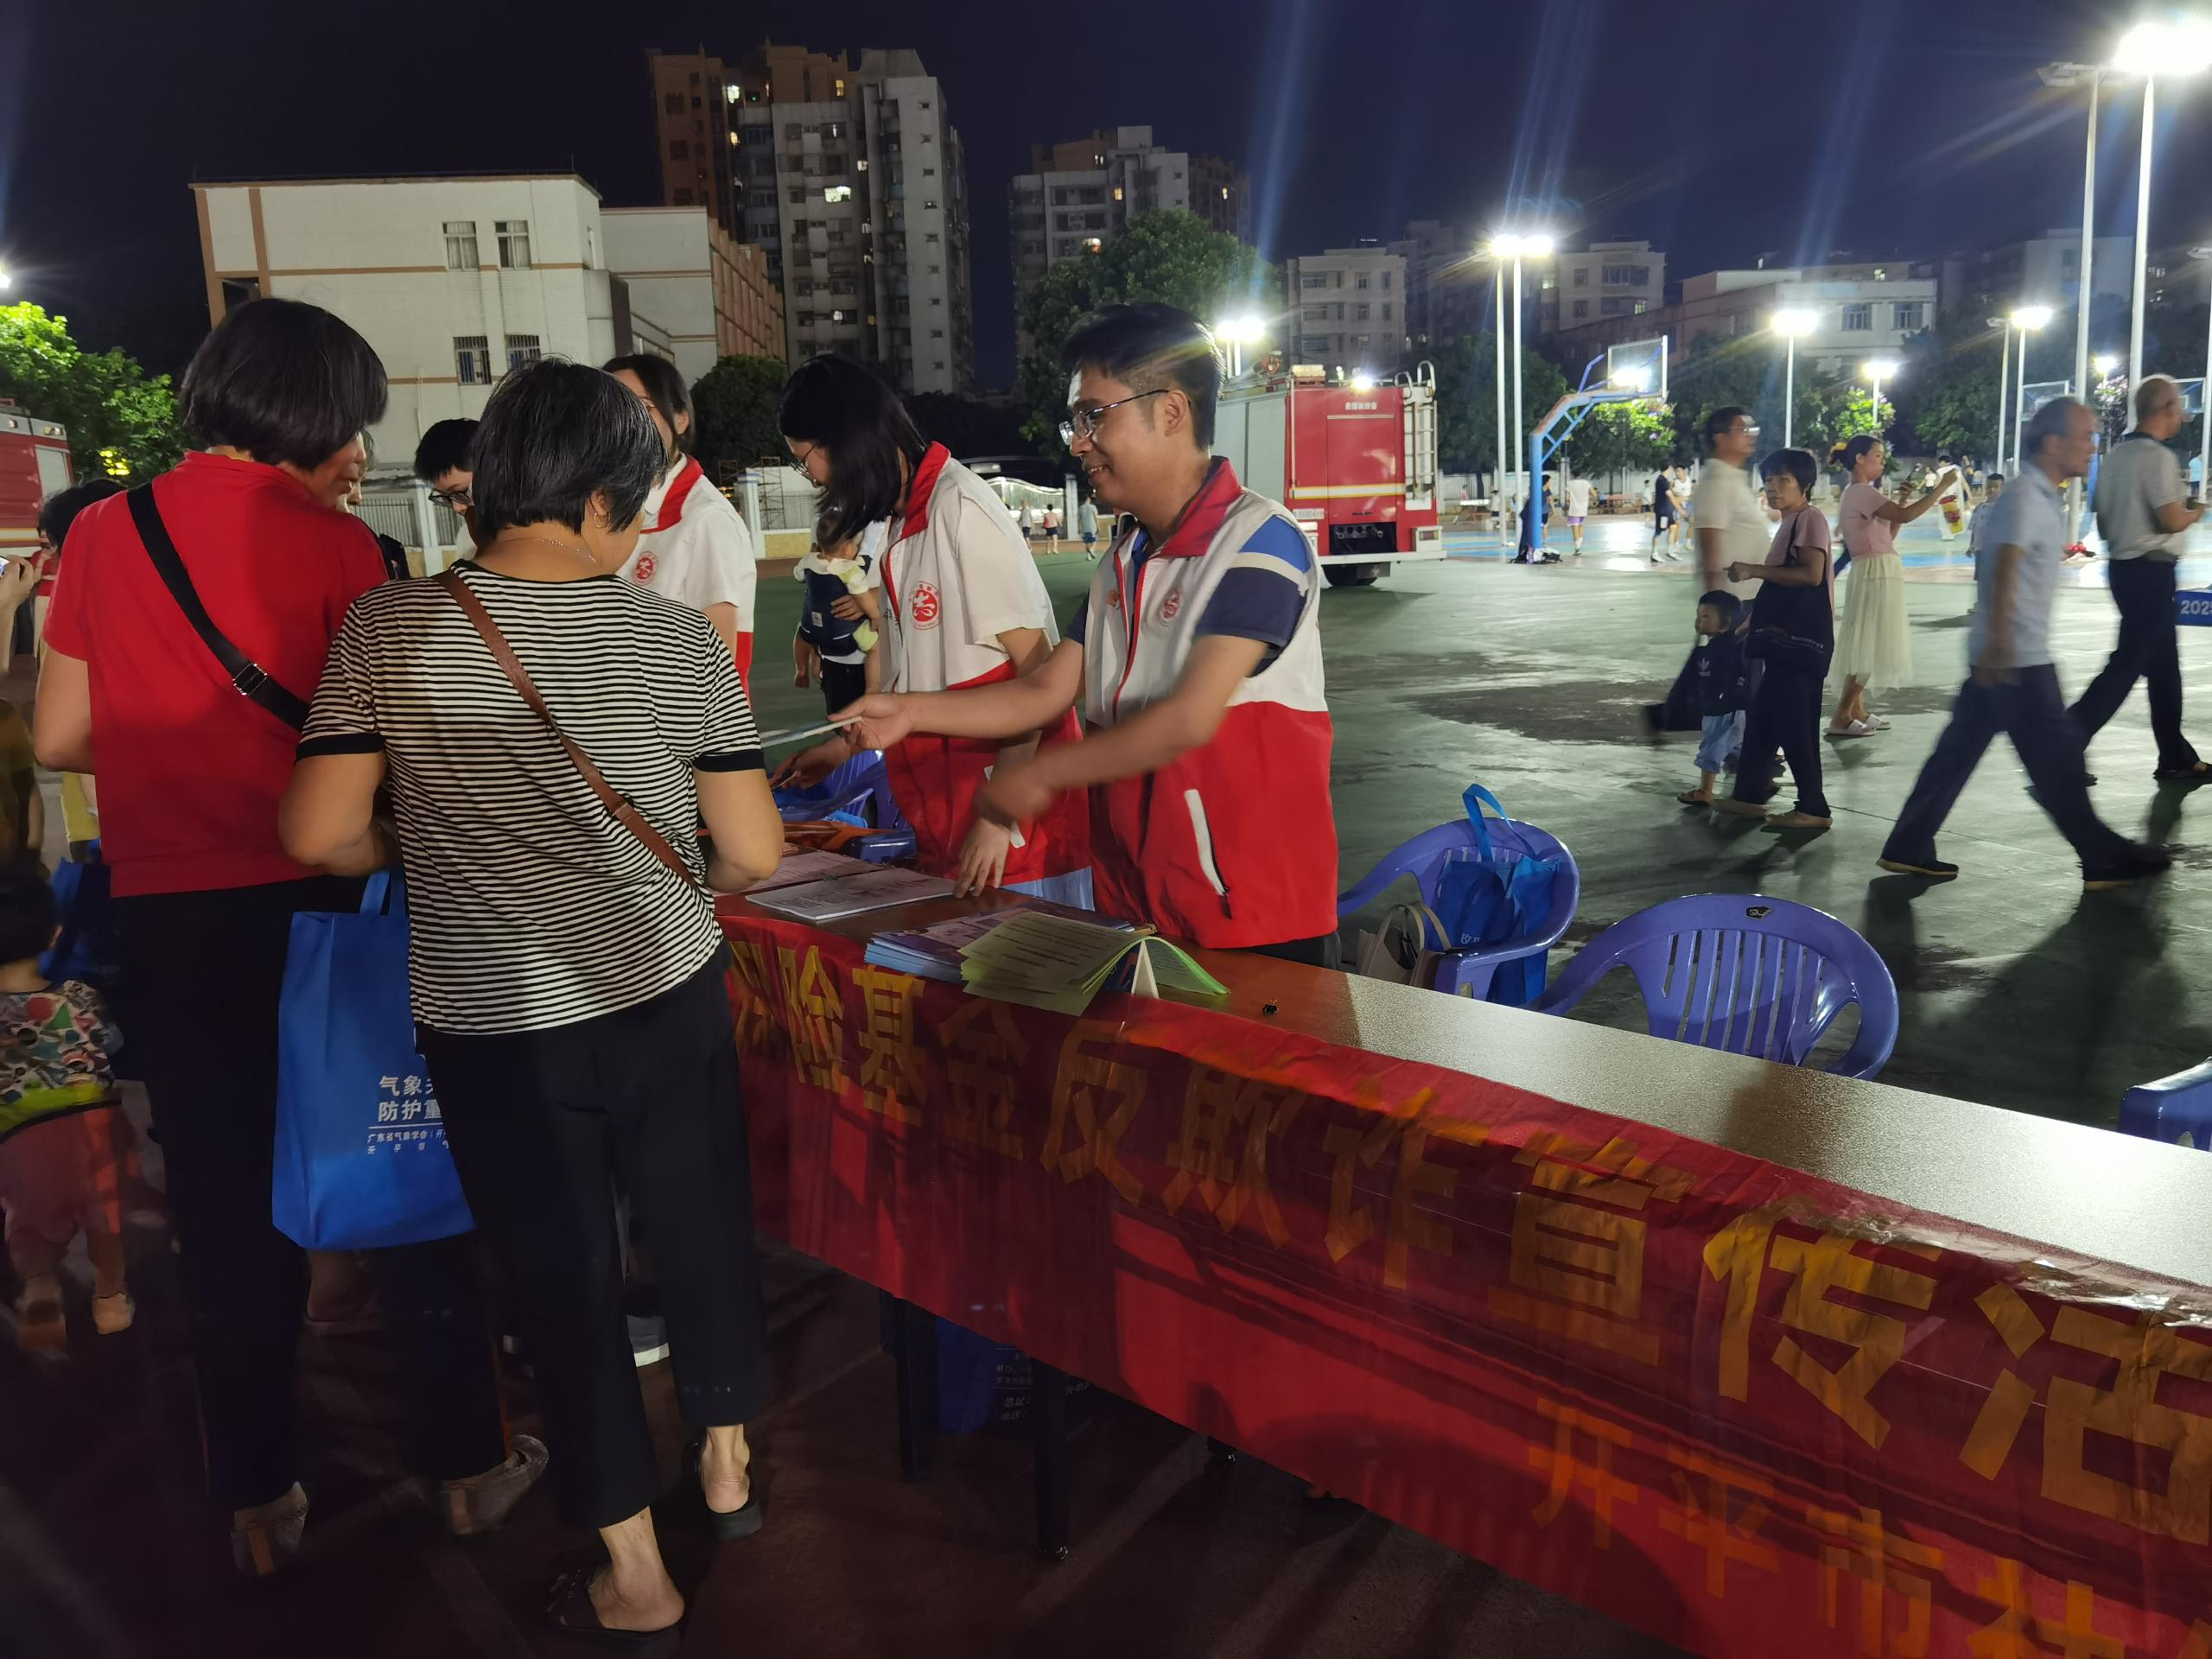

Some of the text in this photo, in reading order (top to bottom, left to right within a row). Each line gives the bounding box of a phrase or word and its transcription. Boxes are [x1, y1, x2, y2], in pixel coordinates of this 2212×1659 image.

[2180, 600, 2212, 615] 202
[1528, 1397, 2212, 1659] 开平市社
